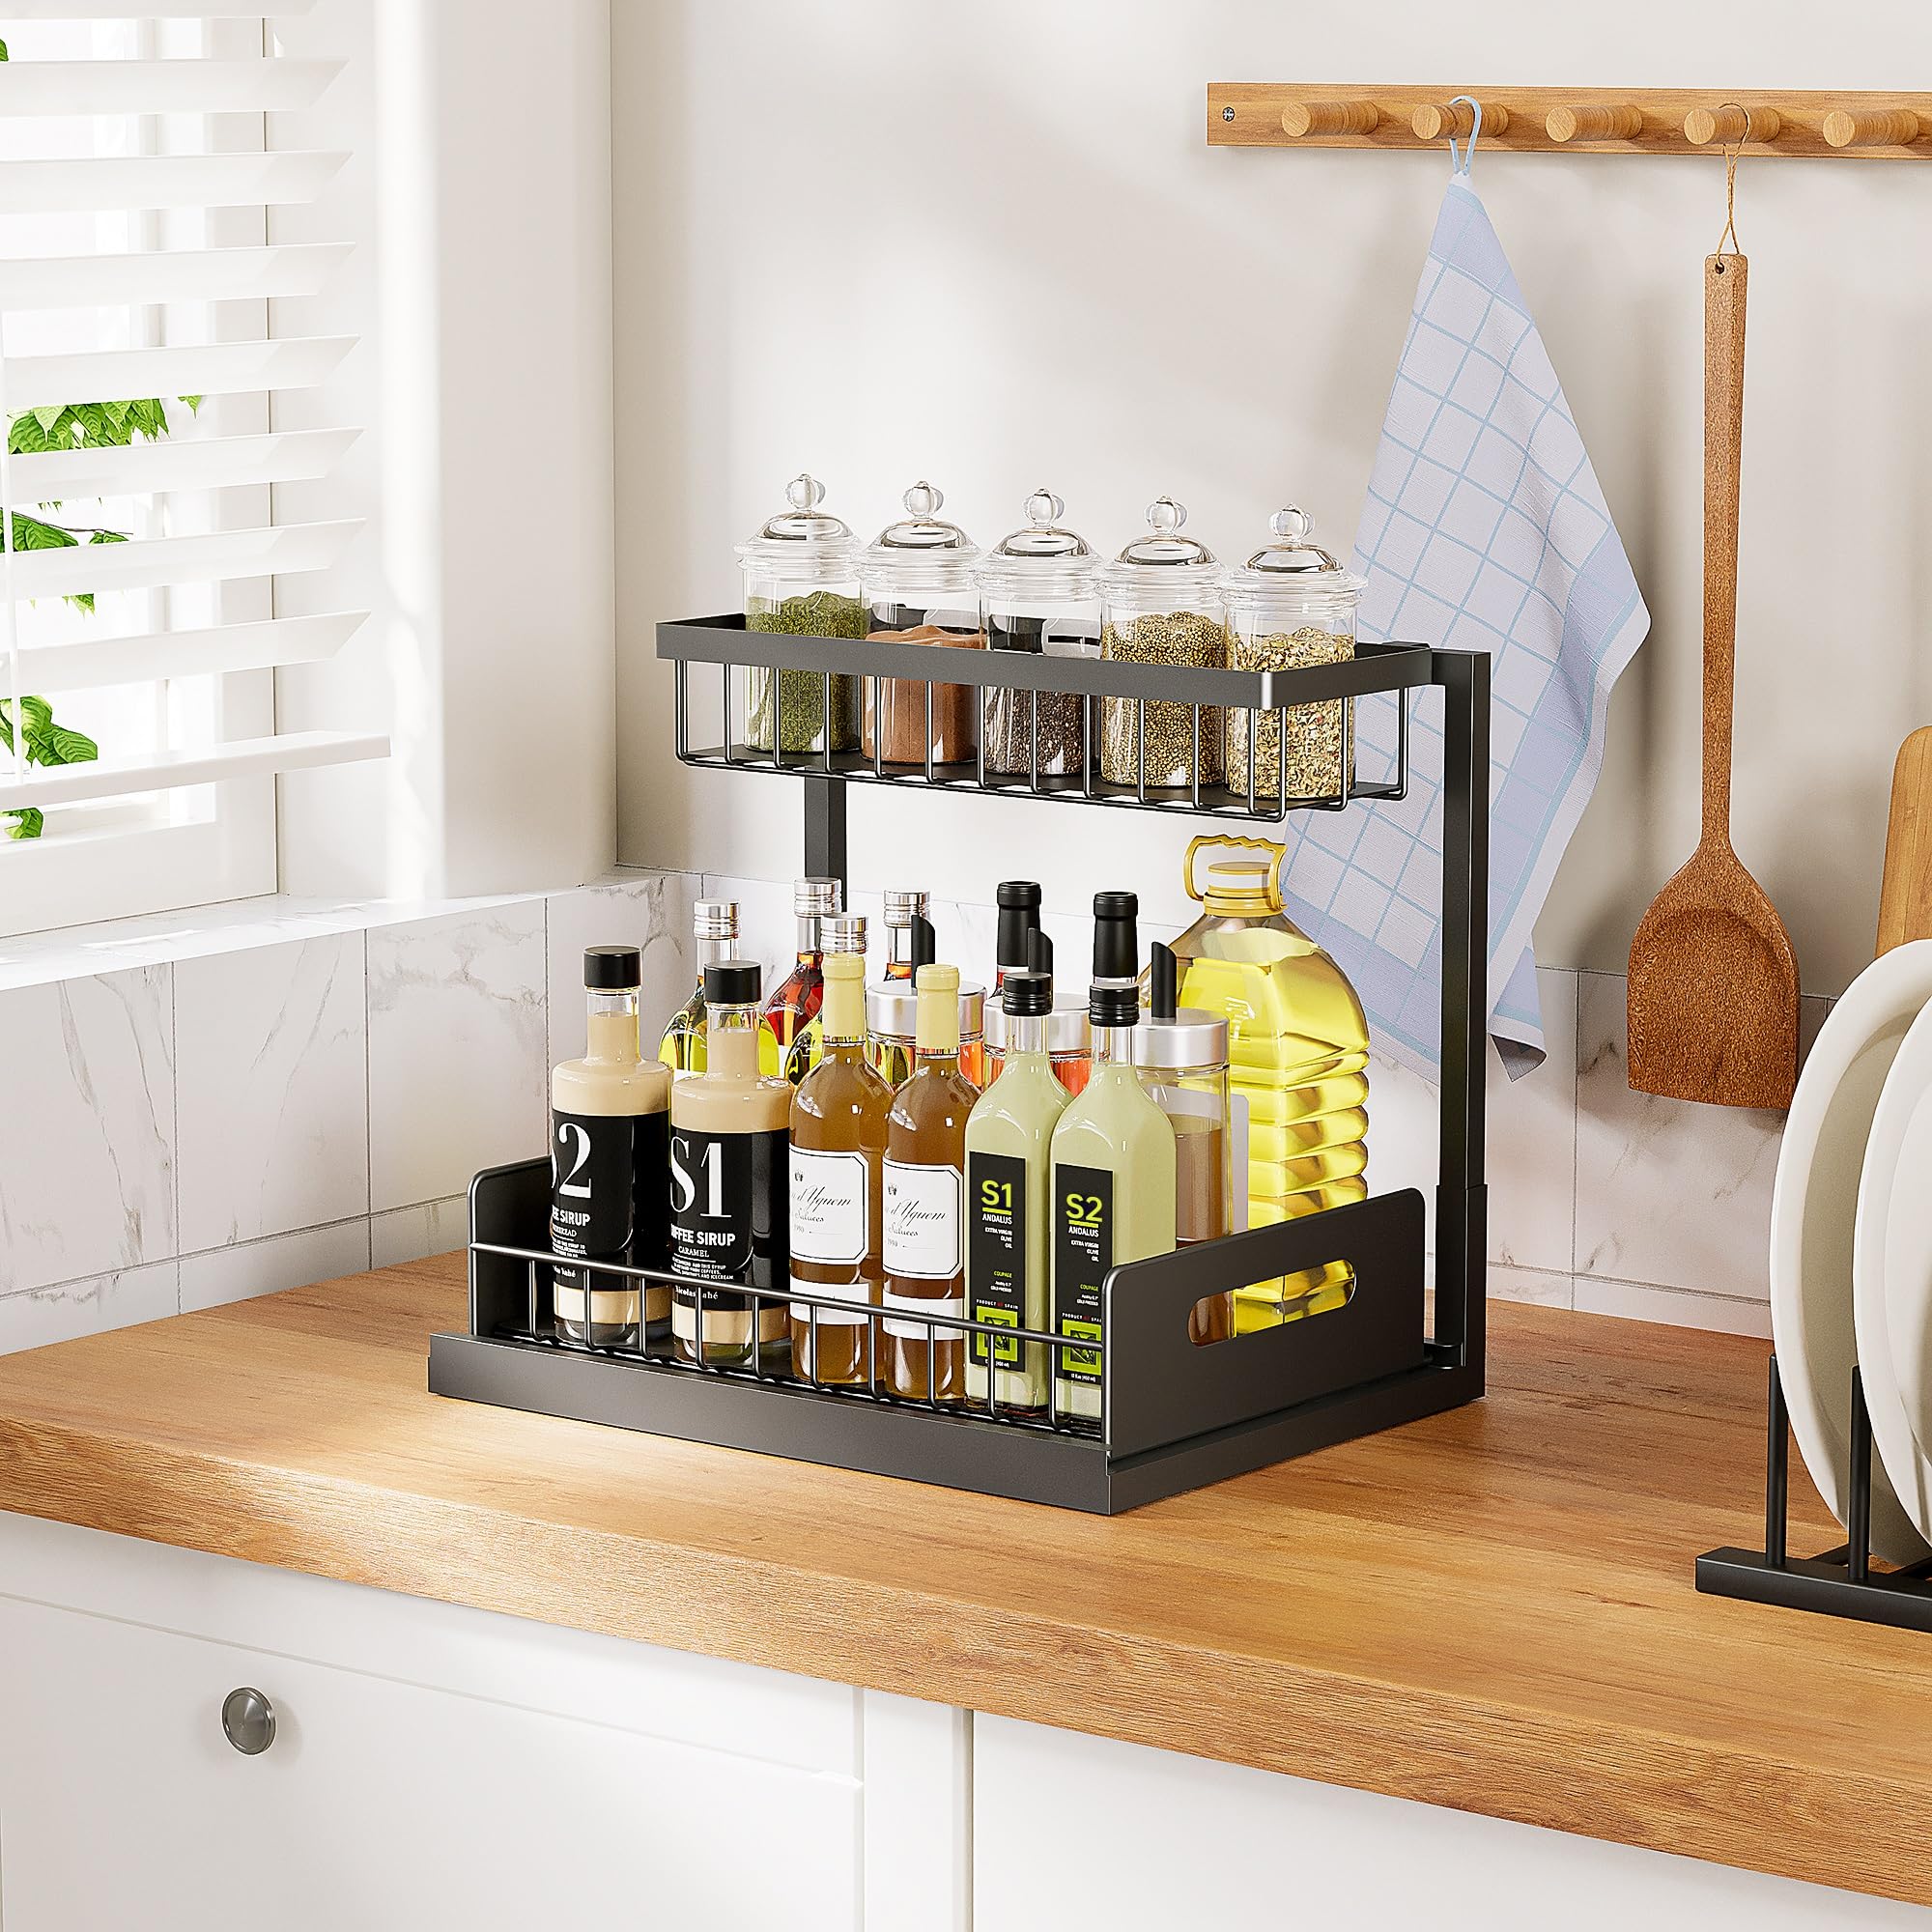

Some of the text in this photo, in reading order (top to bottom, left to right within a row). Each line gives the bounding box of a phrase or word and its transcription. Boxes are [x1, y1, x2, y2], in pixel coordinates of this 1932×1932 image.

[670, 1136, 732, 1218] S1
[981, 1179, 1012, 1208] S1
[1065, 1193, 1103, 1223] S2
[560, 1209, 591, 1227] SIRUP
[981, 1213, 1012, 1225] ANDALUS
[1067, 1226, 1099, 1237] ANDALUS
[696, 1231, 736, 1247] SIRUP
[678, 1246, 710, 1258] CARAMEL
[702, 1291, 719, 1300] ahé
[1079, 1284, 1098, 1293] COUPAGE
